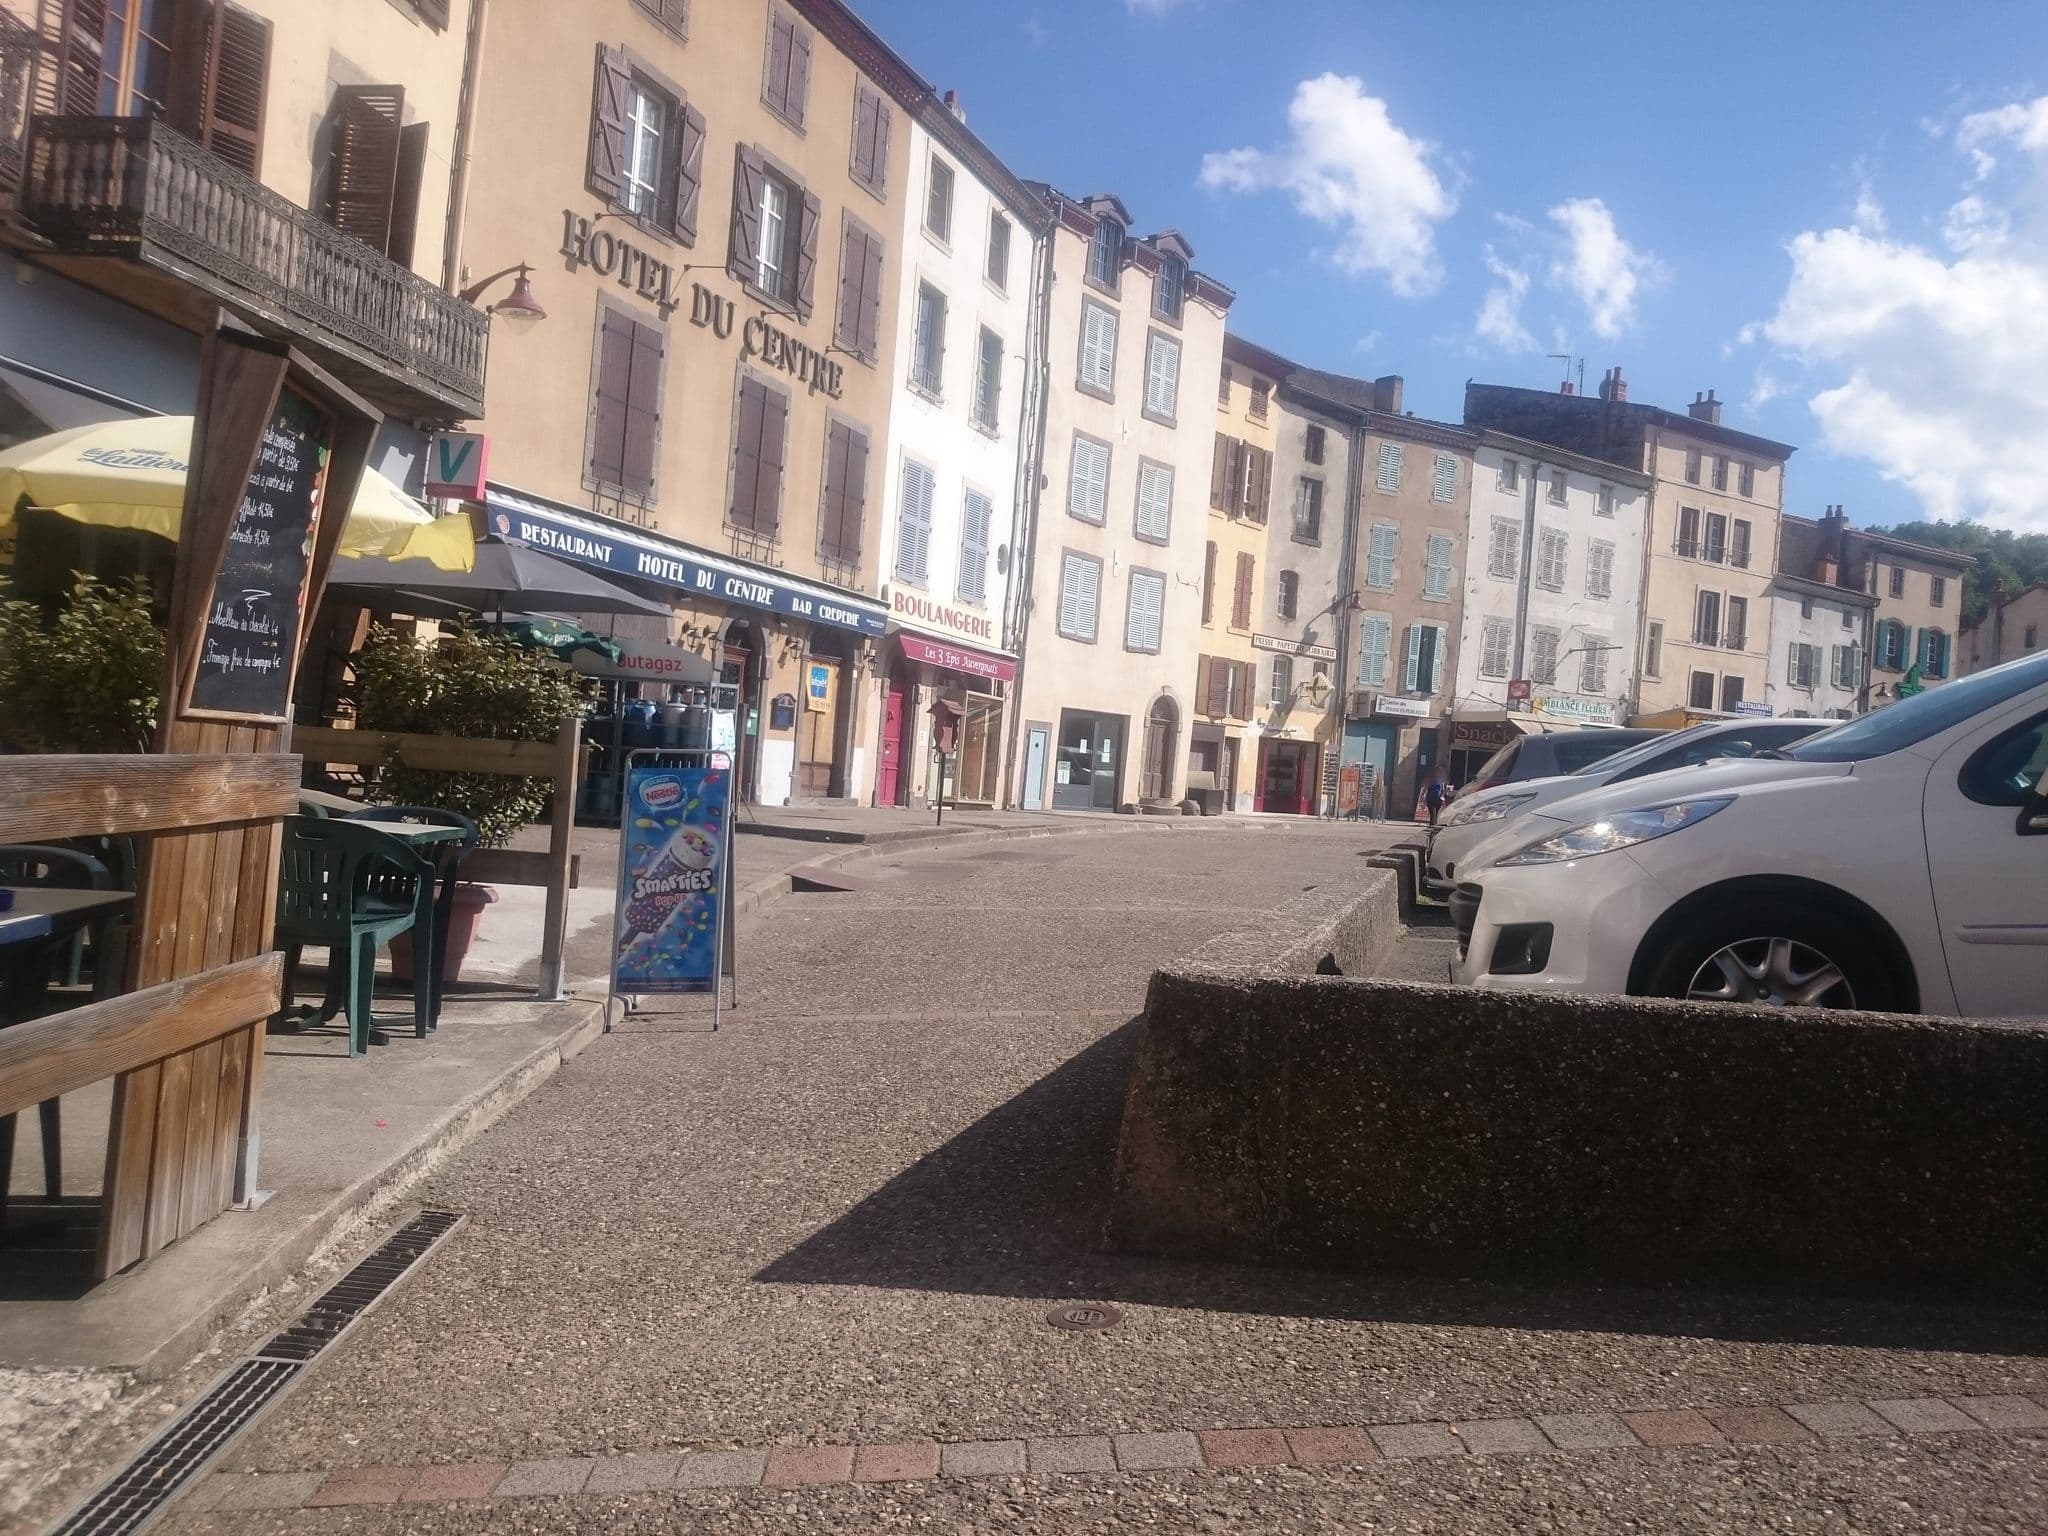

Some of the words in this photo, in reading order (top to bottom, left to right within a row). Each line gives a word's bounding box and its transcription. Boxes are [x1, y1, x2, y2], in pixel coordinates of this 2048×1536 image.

[689, 282, 735, 340] DU
[743, 315, 844, 400] CENTRE
[439, 438, 475, 483] V
[521, 521, 613, 563] RESTAURANT
[638, 552, 686, 584] HOTEL
[697, 569, 717, 591] DU
[725, 578, 775, 606] CENTRE
[792, 597, 813, 616] BAR
[819, 604, 860, 628] CREPERIE
[894, 591, 993, 640] BOULANGERIE
[617, 655, 682, 673] Butagaz
[924, 646, 937, 660] Les
[937, 649, 944, 664] 3
[961, 656, 999, 676] Auvergnats
